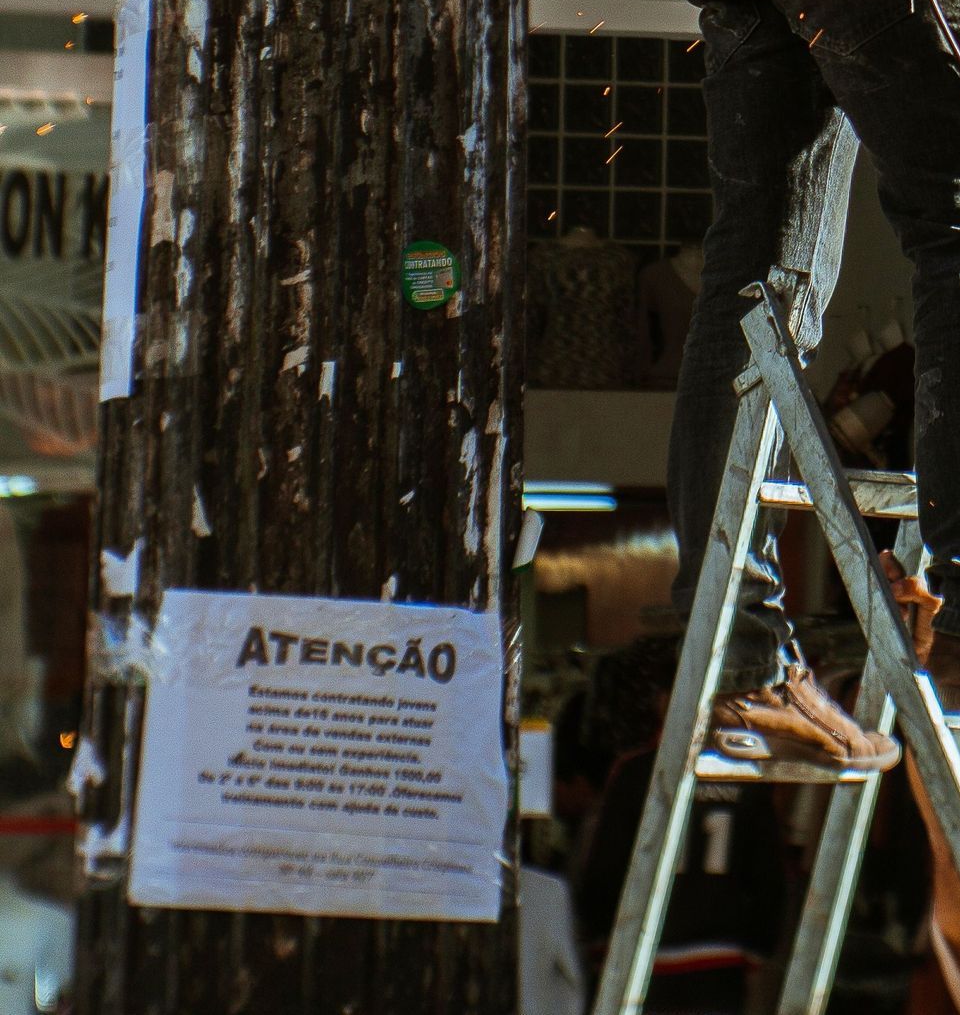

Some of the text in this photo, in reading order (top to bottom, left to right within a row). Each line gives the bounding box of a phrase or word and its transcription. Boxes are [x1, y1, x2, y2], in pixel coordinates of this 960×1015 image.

[235, 625, 457, 684] ATENÇÃO
[248, 683, 437, 712] Estamos contratando jovens
[247, 704, 290, 719] acima
[332, 711, 365, 724] anos
[368, 715, 400, 727] para
[402, 716, 434, 730] atuar
[267, 722, 300, 737] área
[302, 725, 321, 738] de
[324, 728, 373, 742] vendas
[376, 732, 433, 747] externas
[252, 738, 285, 753] Com
[288, 743, 306, 755] ou
[309, 744, 338, 758] sem
[342, 800, 379, 817] ajuda
